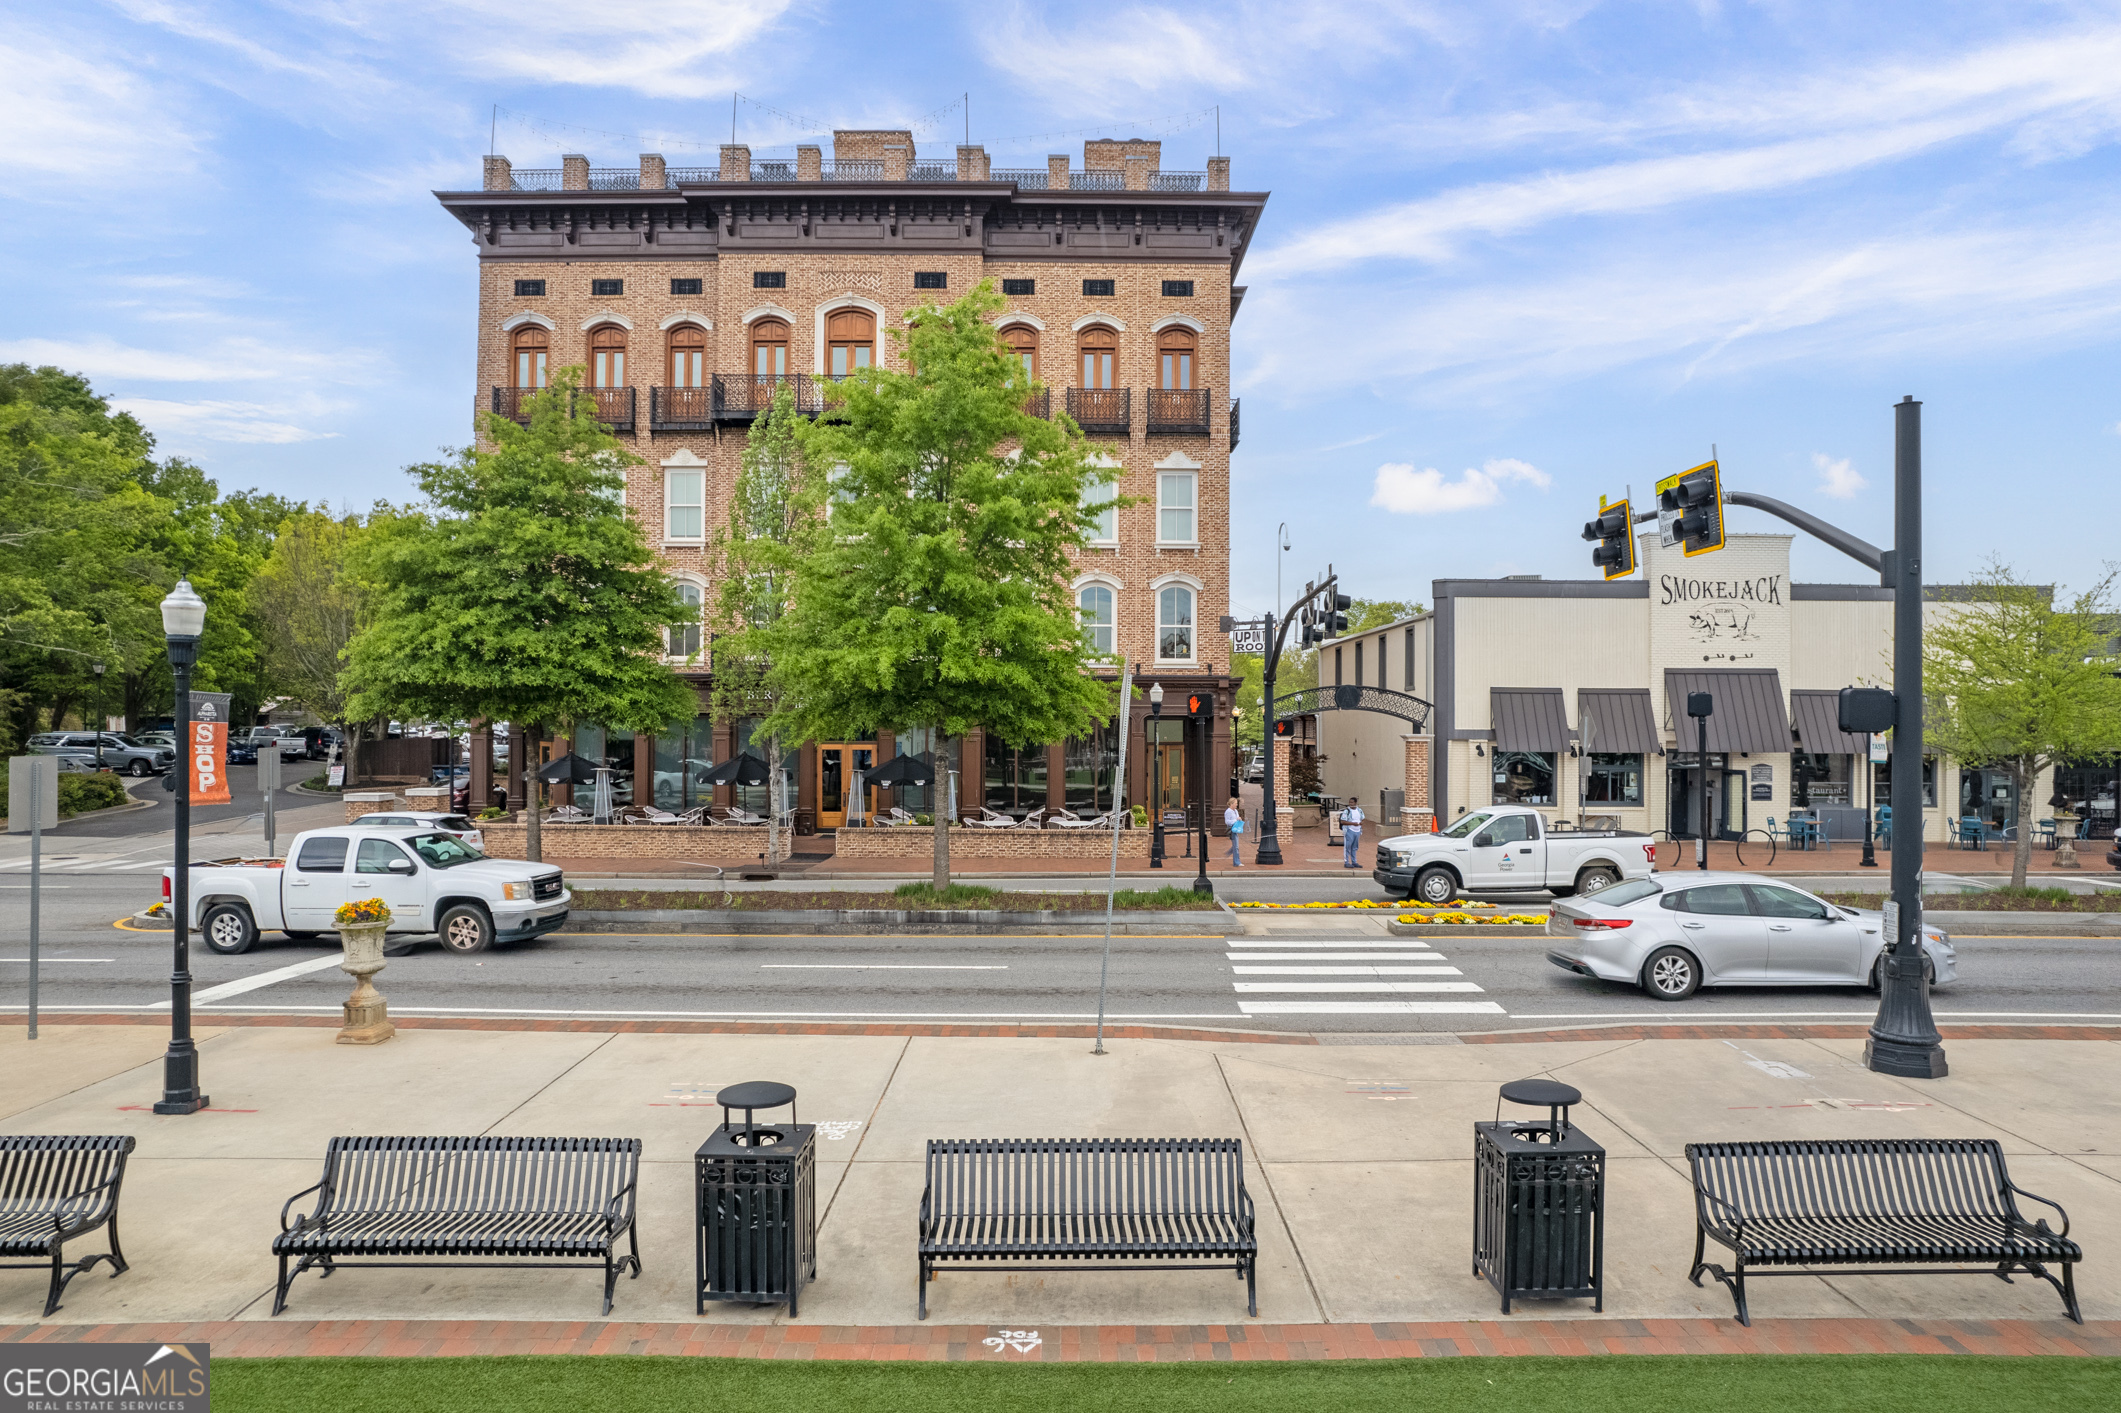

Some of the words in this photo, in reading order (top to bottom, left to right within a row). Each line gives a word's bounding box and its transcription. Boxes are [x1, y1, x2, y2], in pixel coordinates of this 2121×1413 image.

[1661, 574, 1784, 608] SMOKEJACK
[1235, 631, 1252, 643] UP
[1235, 643, 1265, 652] ROO
[195, 723, 216, 793] SHOP
[1798, 786, 1842, 794] estaurant
